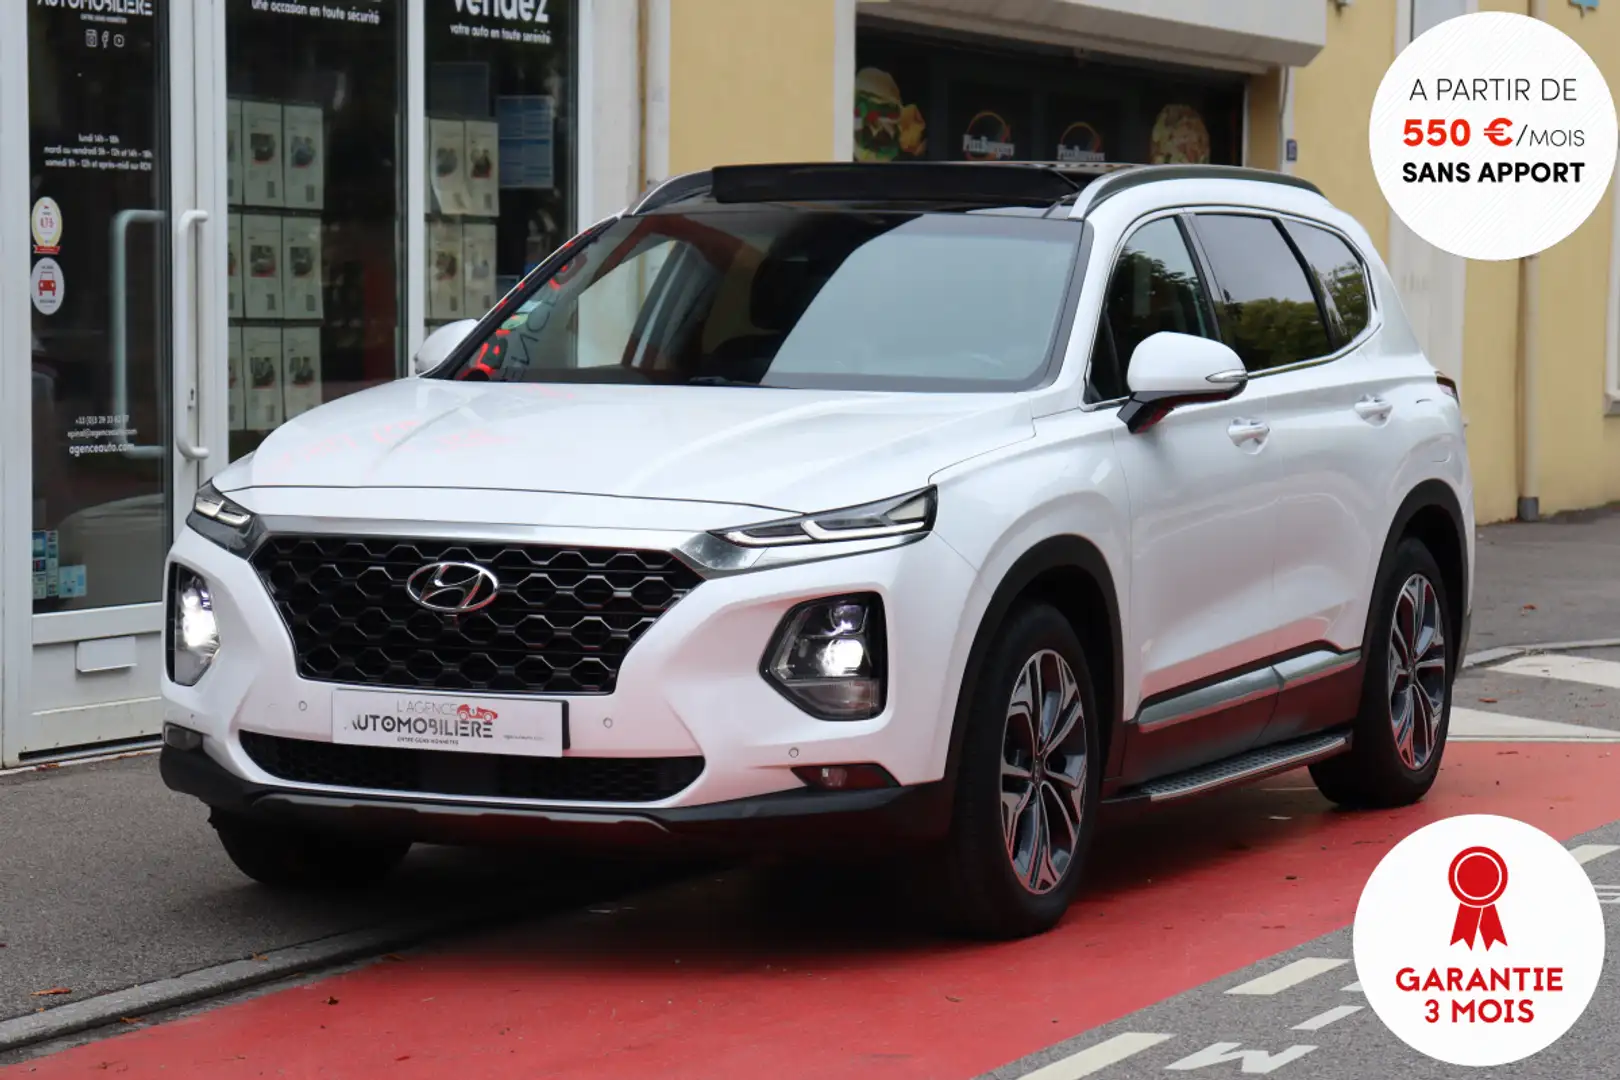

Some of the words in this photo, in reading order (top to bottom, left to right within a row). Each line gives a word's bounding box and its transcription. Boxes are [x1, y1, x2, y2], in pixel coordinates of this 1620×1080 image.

[271, 2, 308, 15] occasion
[309, 6, 320, 17] en
[322, 5, 346, 20] toute
[347, 6, 380, 25] sécurité
[450, 22, 470, 36] votre
[471, 25, 489, 38] auto
[490, 28, 500, 39] en
[501, 28, 521, 42] toute
[397, 700, 458, 716] L'AGENCE
